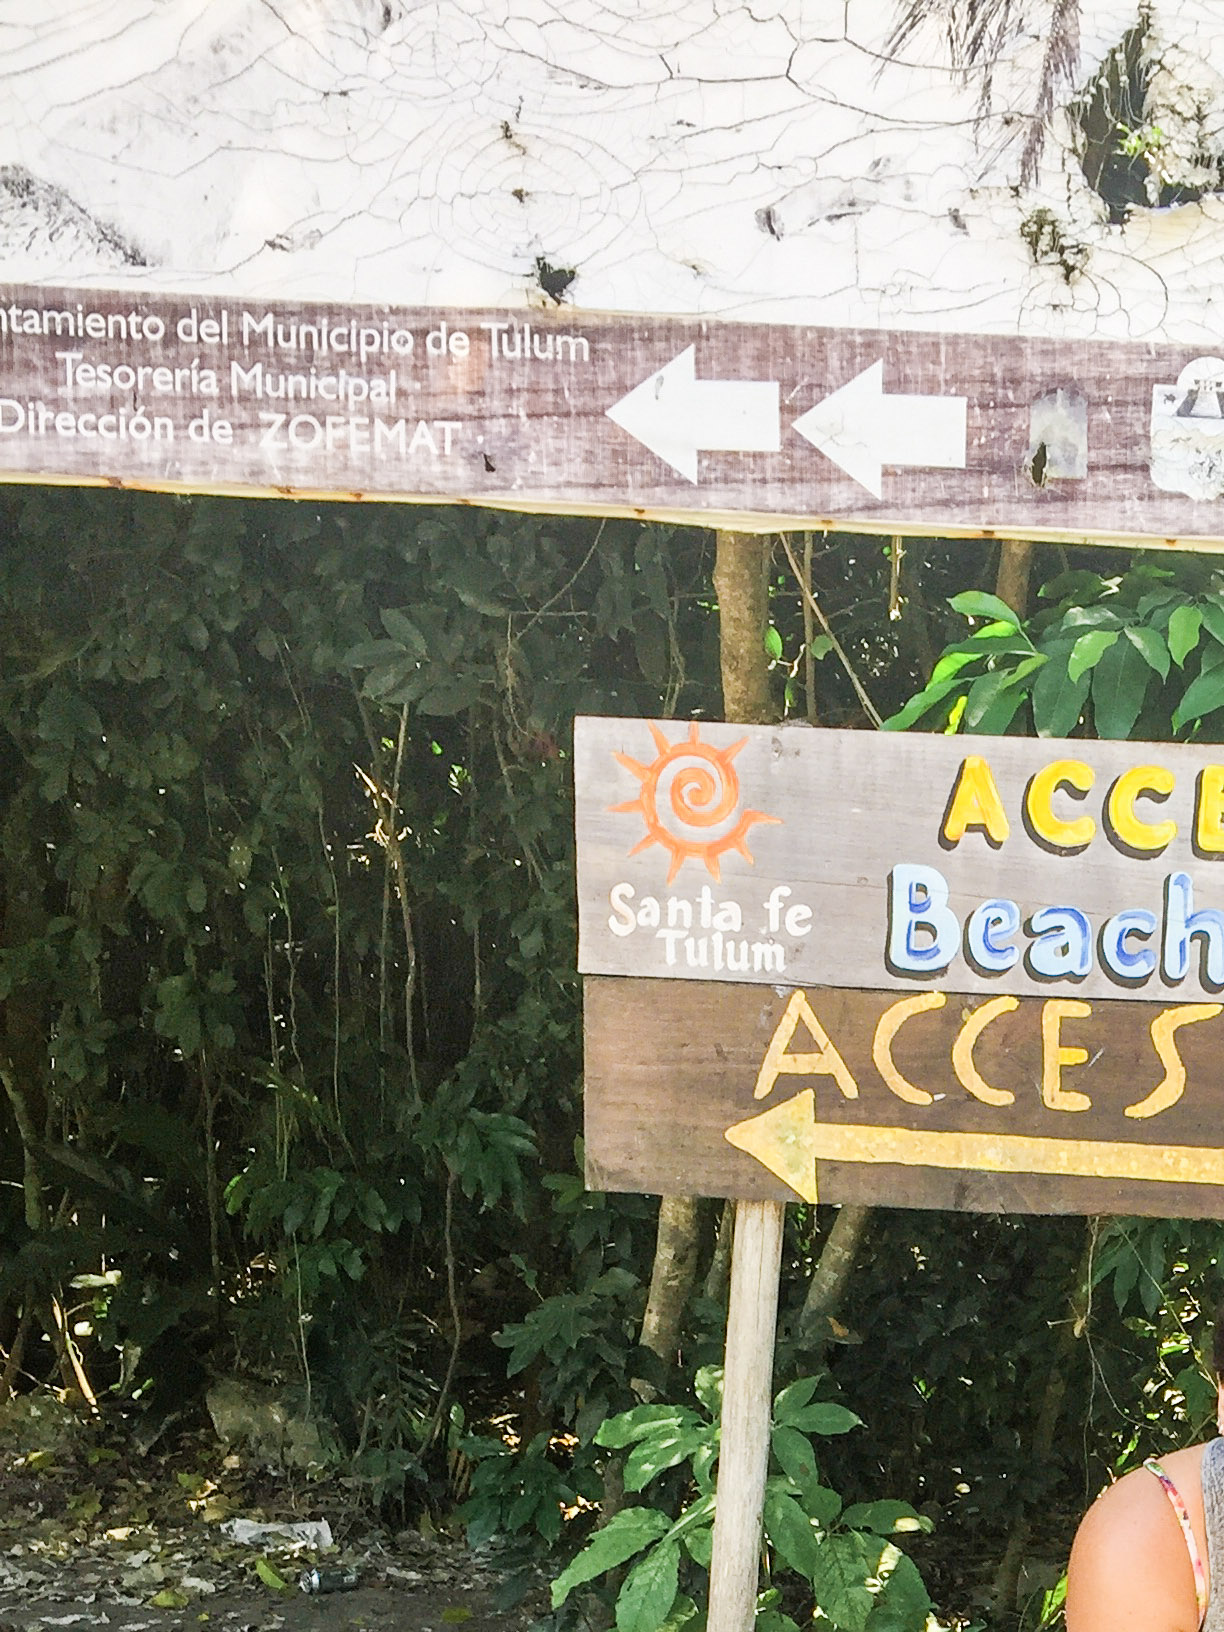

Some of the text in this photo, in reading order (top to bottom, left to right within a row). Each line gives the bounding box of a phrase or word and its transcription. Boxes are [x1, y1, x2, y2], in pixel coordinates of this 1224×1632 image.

[177, 308, 228, 346] del
[242, 310, 414, 363] Municipio
[426, 321, 470, 356] de
[480, 322, 590, 361] Tulum
[55, 351, 397, 408] Tesorería Municipal
[0, 398, 463, 455] Dirección de ZOFEMAT
[608, 882, 813, 937] Santa fe
[655, 928, 787, 973] Tulum
